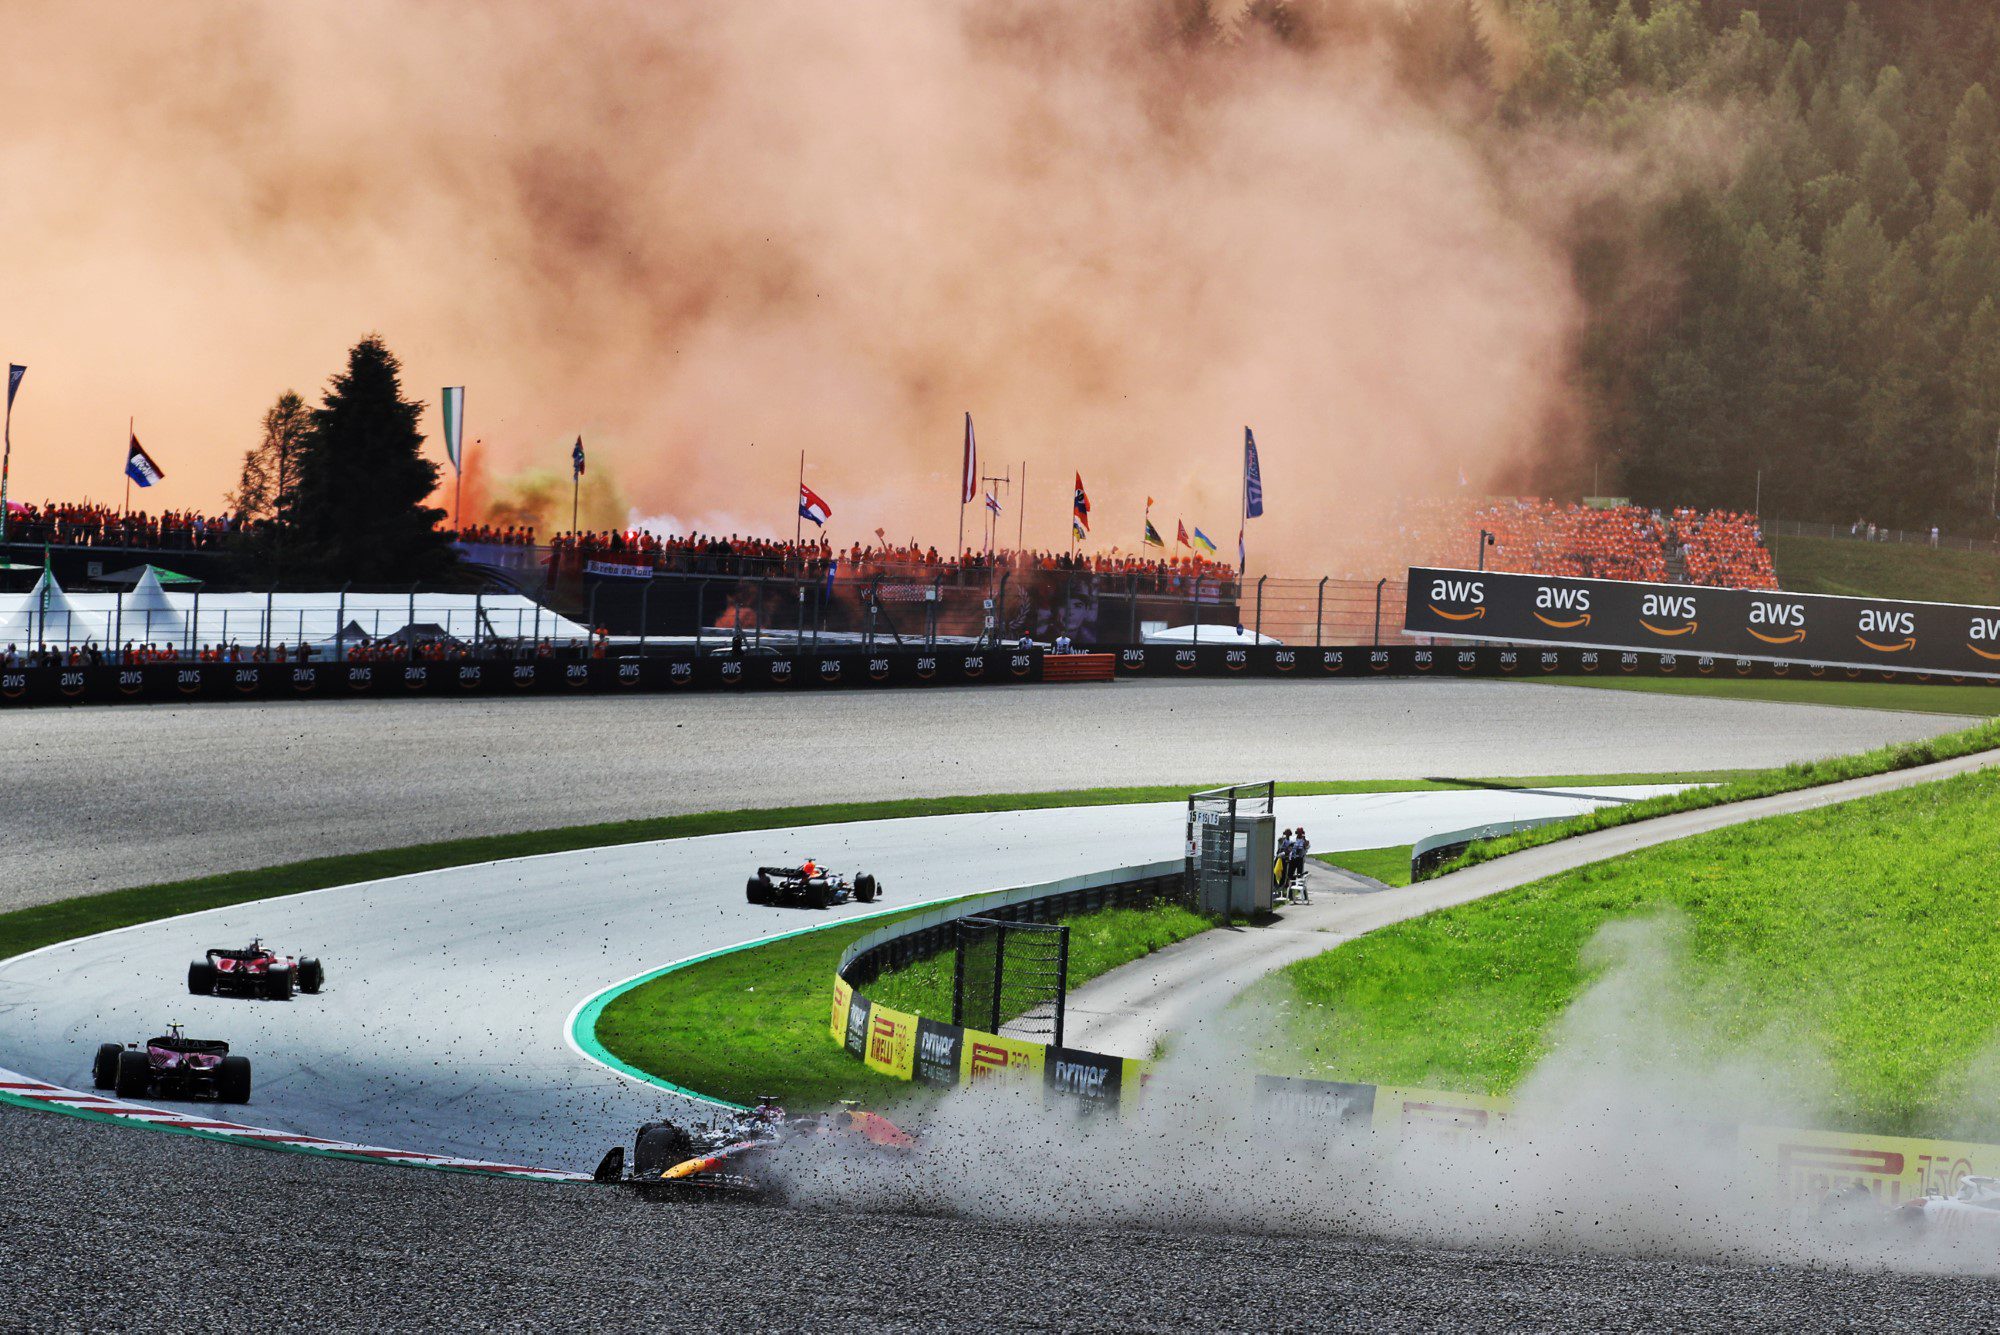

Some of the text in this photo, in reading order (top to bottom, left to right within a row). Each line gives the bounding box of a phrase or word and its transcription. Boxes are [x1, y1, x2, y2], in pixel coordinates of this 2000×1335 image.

[1431, 579, 1485, 604] aws
[1536, 586, 1590, 611] aws
[1642, 593, 1697, 619] aws
[1749, 601, 1805, 627] aws
[1858, 609, 1915, 635] aws
[1969, 617, 2000, 640] aw
[1011, 655, 1030, 667] aws
[1123, 649, 1144, 661] aws
[1175, 650, 1196, 662] aws
[1226, 650, 1246, 662] aws
[1276, 651, 1295, 662] aws
[1324, 652, 1342, 662] aws
[1371, 651, 1388, 662] aws
[1415, 651, 1432, 662] aws
[1458, 651, 1475, 662] aws
[1500, 652, 1517, 663] aws
[1541, 652, 1558, 663] aws
[1582, 652, 1598, 663] aws
[1621, 653, 1638, 664] aws
[1660, 654, 1677, 664] aws
[722, 662, 742, 674] aws
[772, 661, 792, 673] aws
[821, 660, 841, 672] aws
[870, 659, 888, 672] aws
[917, 658, 936, 670] aws
[965, 657, 983, 668] aws
[293, 668, 315, 682] aws
[349, 667, 371, 681] aws
[405, 666, 427, 680] aws
[459, 666, 481, 679] aws
[513, 665, 534, 678] aws
[566, 664, 588, 677] aws
[619, 663, 640, 677] aws
[671, 662, 691, 676] aws
[2, 674, 25, 687] aws
[61, 672, 84, 686] aws
[120, 671, 142, 685] aws
[178, 670, 200, 683] aws
[235, 669, 258, 682] aws
[169, 1039, 207, 1048] VELAS
